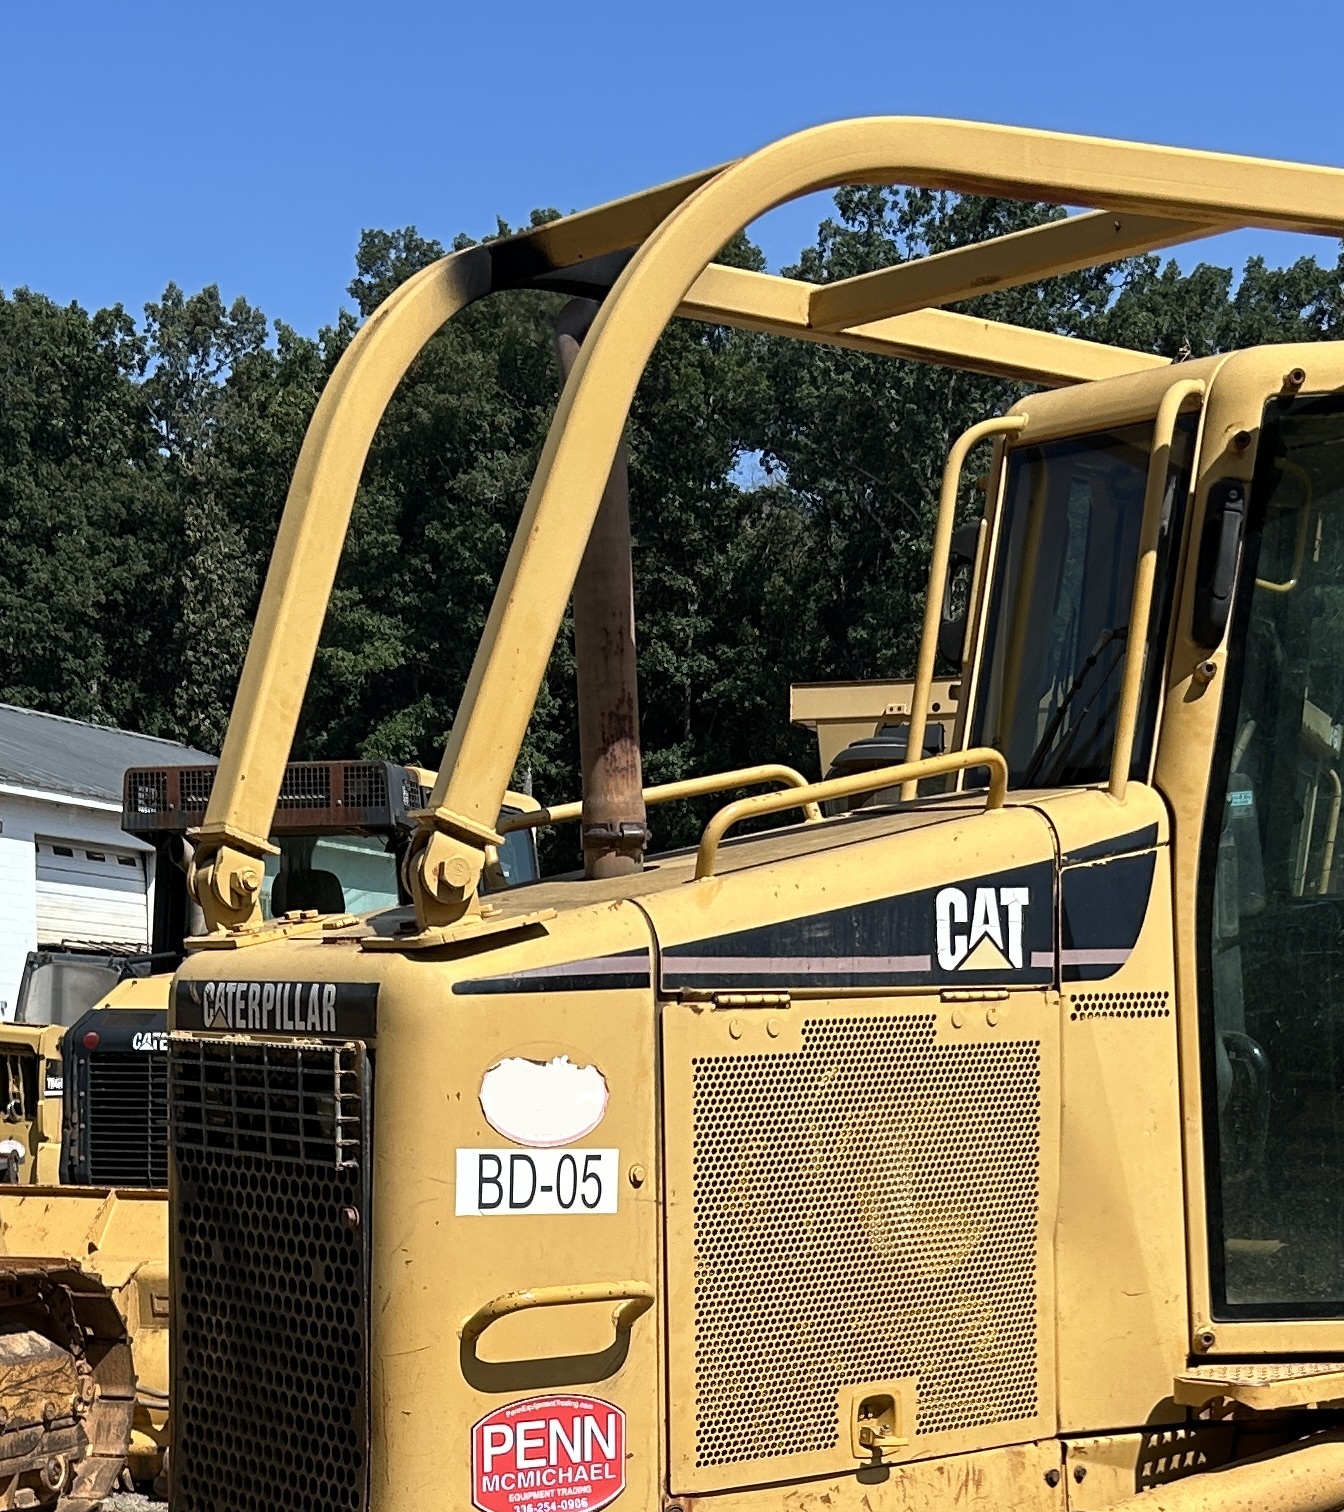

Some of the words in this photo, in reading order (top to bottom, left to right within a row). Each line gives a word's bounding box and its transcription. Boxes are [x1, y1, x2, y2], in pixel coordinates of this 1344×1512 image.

[936, 887, 1029, 971] CAT
[203, 982, 337, 1032] CATERPILLAR
[478, 1153, 602, 1210] BD-05
[482, 1413, 617, 1473] PENN
[482, 1463, 617, 1493] MCMICHAEL
[508, 1488, 555, 1503] EQUIPMENT
[557, 1485, 592, 1497] TRADING
